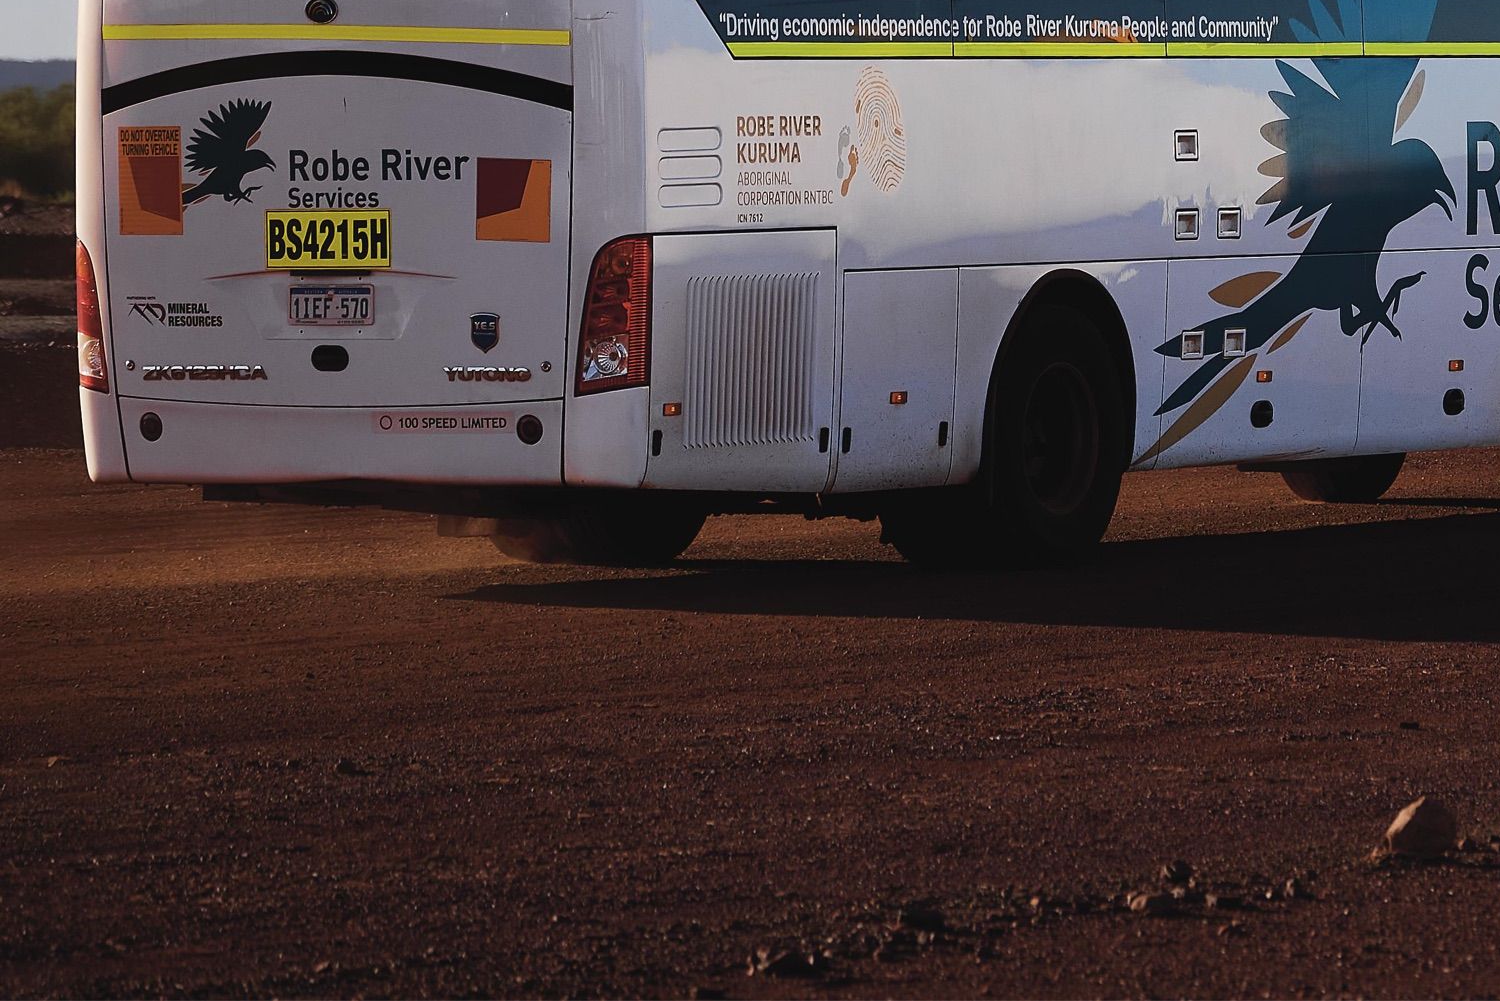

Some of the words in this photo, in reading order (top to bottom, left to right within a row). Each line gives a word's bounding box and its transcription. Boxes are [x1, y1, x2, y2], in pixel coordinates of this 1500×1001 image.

[783, 13, 855, 37] economic
[858, 14, 960, 41] independence
[963, 15, 983, 37] for
[986, 15, 1021, 37] Robe
[1026, 14, 1062, 37] River
[1065, 14, 1118, 38] Kuruma
[1122, 15, 1168, 41] People
[1171, 16, 1196, 38] and
[736, 116, 775, 137] ROBE
[780, 115, 822, 136] RIVER
[120, 130, 130, 142] DO
[131, 130, 144, 142] NOT
[145, 129, 179, 142] OVERTAKE
[122, 144, 150, 156] TURNING
[150, 144, 178, 155] VEHICLE
[737, 142, 801, 164] KURUMA
[289, 149, 370, 182] Robe
[381, 149, 470, 181] River
[738, 171, 792, 186] ABORIGINAL
[288, 187, 380, 209] Services
[738, 190, 802, 206] CORPORATION
[804, 190, 834, 205] RNTBC
[737, 214, 748, 224] ICN
[749, 213, 764, 223] 7612
[269, 218, 388, 260] BS4215H
[168, 302, 210, 314] MINERAL
[168, 316, 223, 328] RESOURCES
[474, 321, 496, 330] YES
[443, 366, 532, 382] YUTONG
[398, 417, 419, 429] 100
[422, 417, 458, 429] SPEED
[461, 417, 507, 429] LIMITED
